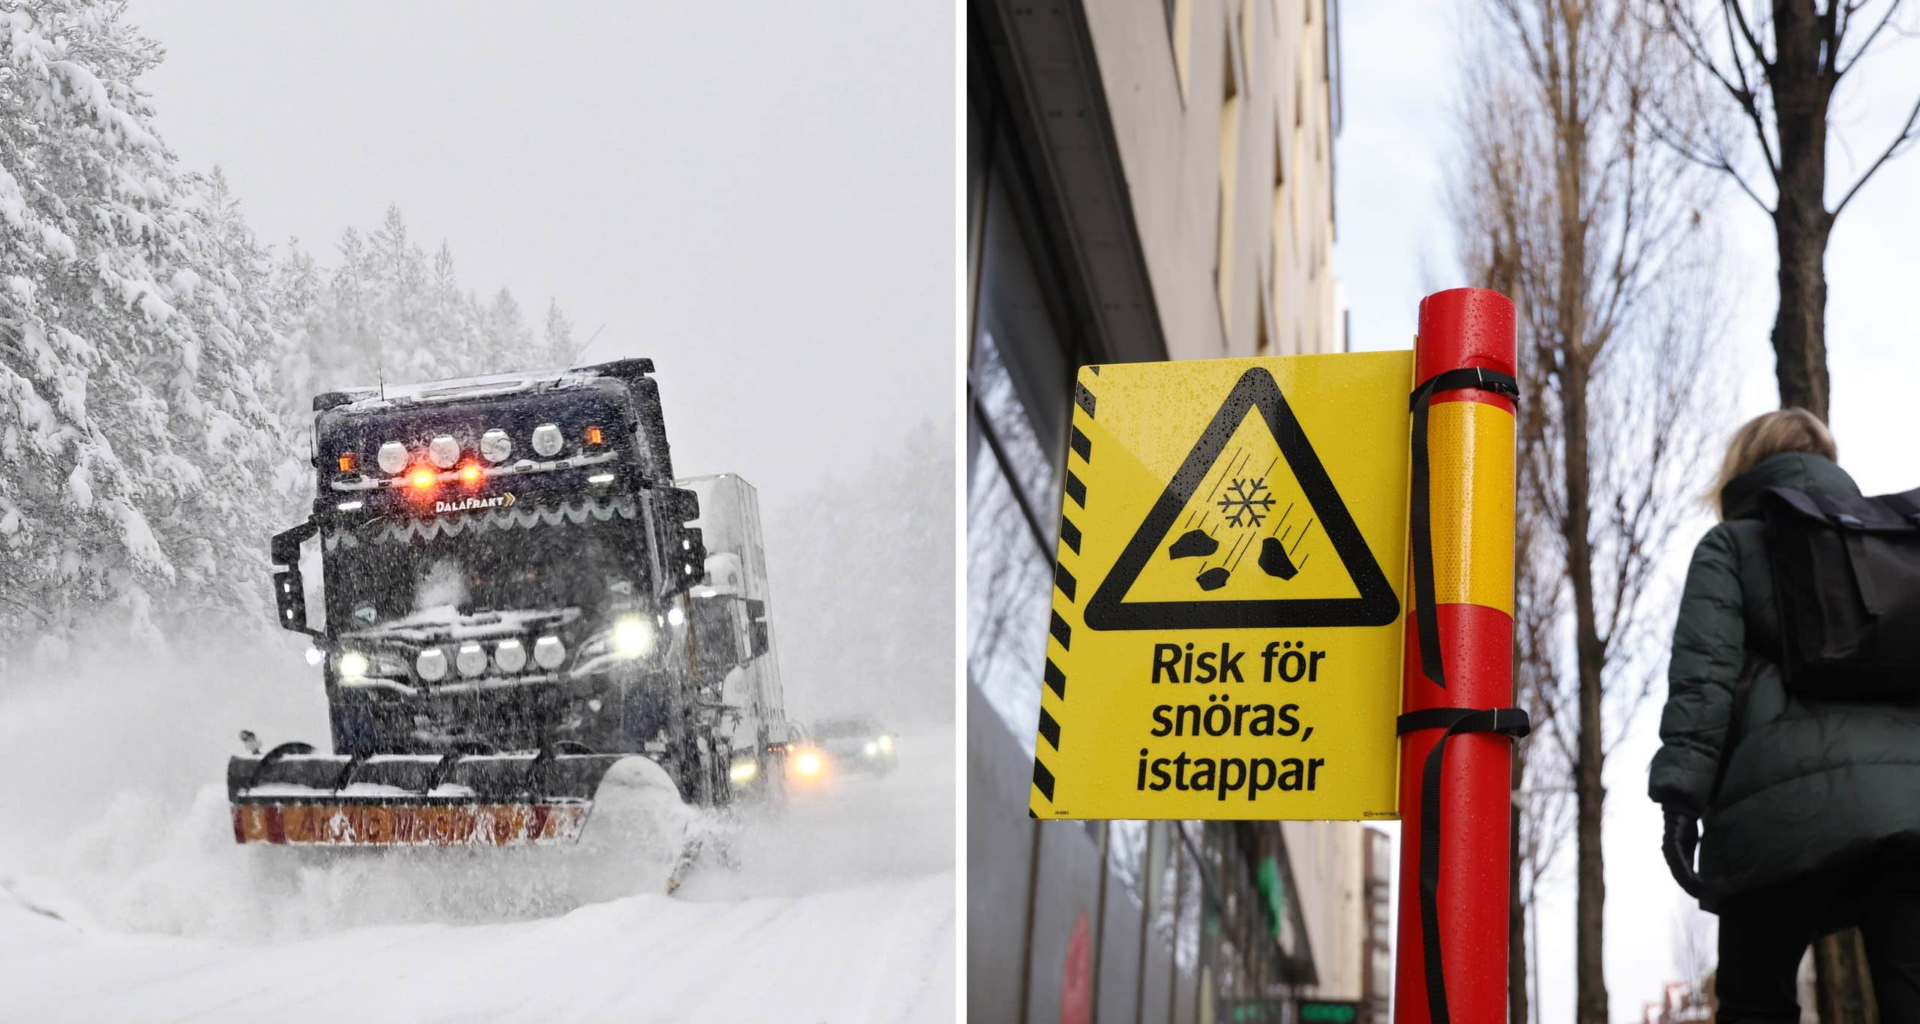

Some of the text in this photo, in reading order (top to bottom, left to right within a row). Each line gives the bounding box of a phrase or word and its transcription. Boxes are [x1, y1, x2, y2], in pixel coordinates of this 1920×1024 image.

[1152, 640, 1326, 684] Risk för
[1150, 693, 1314, 742] snöras,
[1137, 748, 1325, 801] istappar
